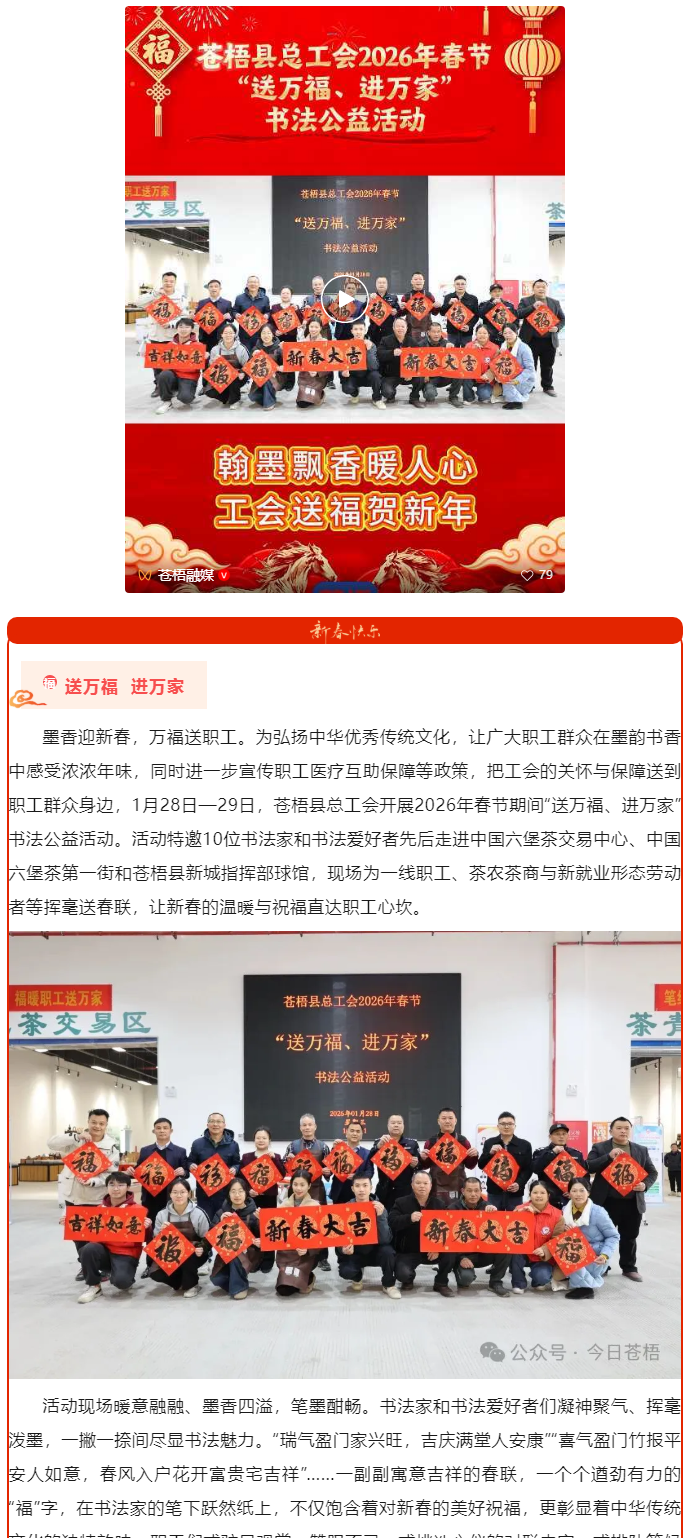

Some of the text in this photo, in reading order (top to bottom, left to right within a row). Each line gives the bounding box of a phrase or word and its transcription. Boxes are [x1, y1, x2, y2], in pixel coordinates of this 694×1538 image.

[142, 34, 174, 65] 福
[197, 42, 492, 70] 苍梧县总工会2026年春节
[238, 74, 452, 101] “送万福、进万家”
[265, 106, 426, 133] 书法公益活动
[300, 188, 400, 200] 苍梧县总工会2026年春节
[125, 200, 205, 218] 交易区
[323, 243, 379, 254] 书法公益活动
[148, 348, 203, 366] 吉祥如意
[287, 346, 362, 366] 新春大吉
[403, 354, 477, 373] 新春大吉
[215, 446, 477, 484] 翰墨飘香暖人心
[215, 493, 477, 531] 工会送福贺新年
[310, 620, 380, 644] 新春快乐
[43, 676, 58, 690] 福
[64, 677, 184, 695] 送万福 进万家
[15, 990, 103, 1007] 福暖职工送万家
[283, 994, 422, 1008] 苍梧县总工会2026年春节
[9, 1011, 151, 1036] 茶交易区
[275, 1033, 429, 1051] “送万福、进万家”
[314, 1071, 390, 1084] 书法公益活动
[329, 1110, 380, 1118] 2026年01月28日
[72, 1151, 97, 1173] 福
[140, 1163, 165, 1187] 福
[68, 1213, 142, 1235] 吉祥如意
[265, 1211, 370, 1243] 新春大吉
[424, 1218, 528, 1247] 新春大吉
[215, 1223, 242, 1251] 福
[555, 1237, 583, 1264] 福
